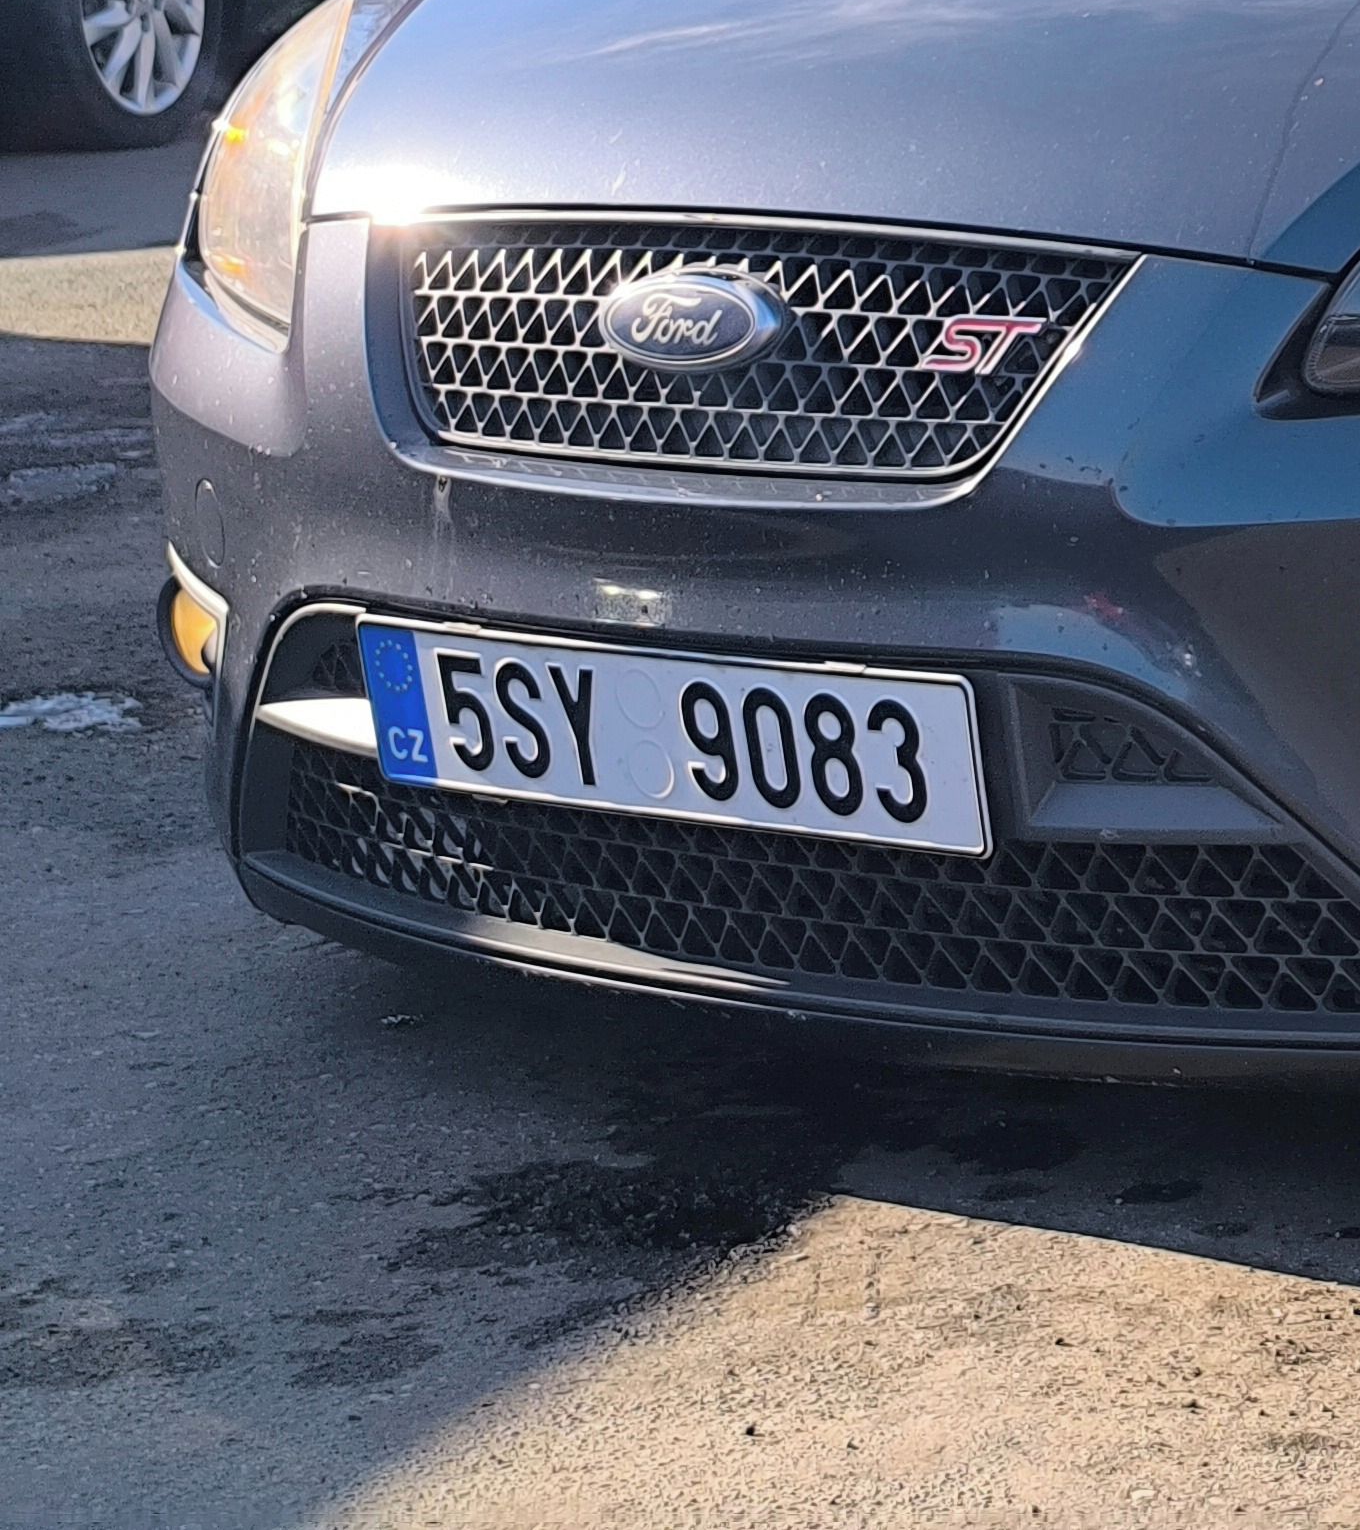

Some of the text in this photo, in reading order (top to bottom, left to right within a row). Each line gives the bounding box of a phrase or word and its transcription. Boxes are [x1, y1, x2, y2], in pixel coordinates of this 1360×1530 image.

[631, 292, 722, 347] Ford
[922, 316, 1049, 375] ST
[388, 725, 429, 763] CZ
[435, 650, 928, 824] 5SY 9083
